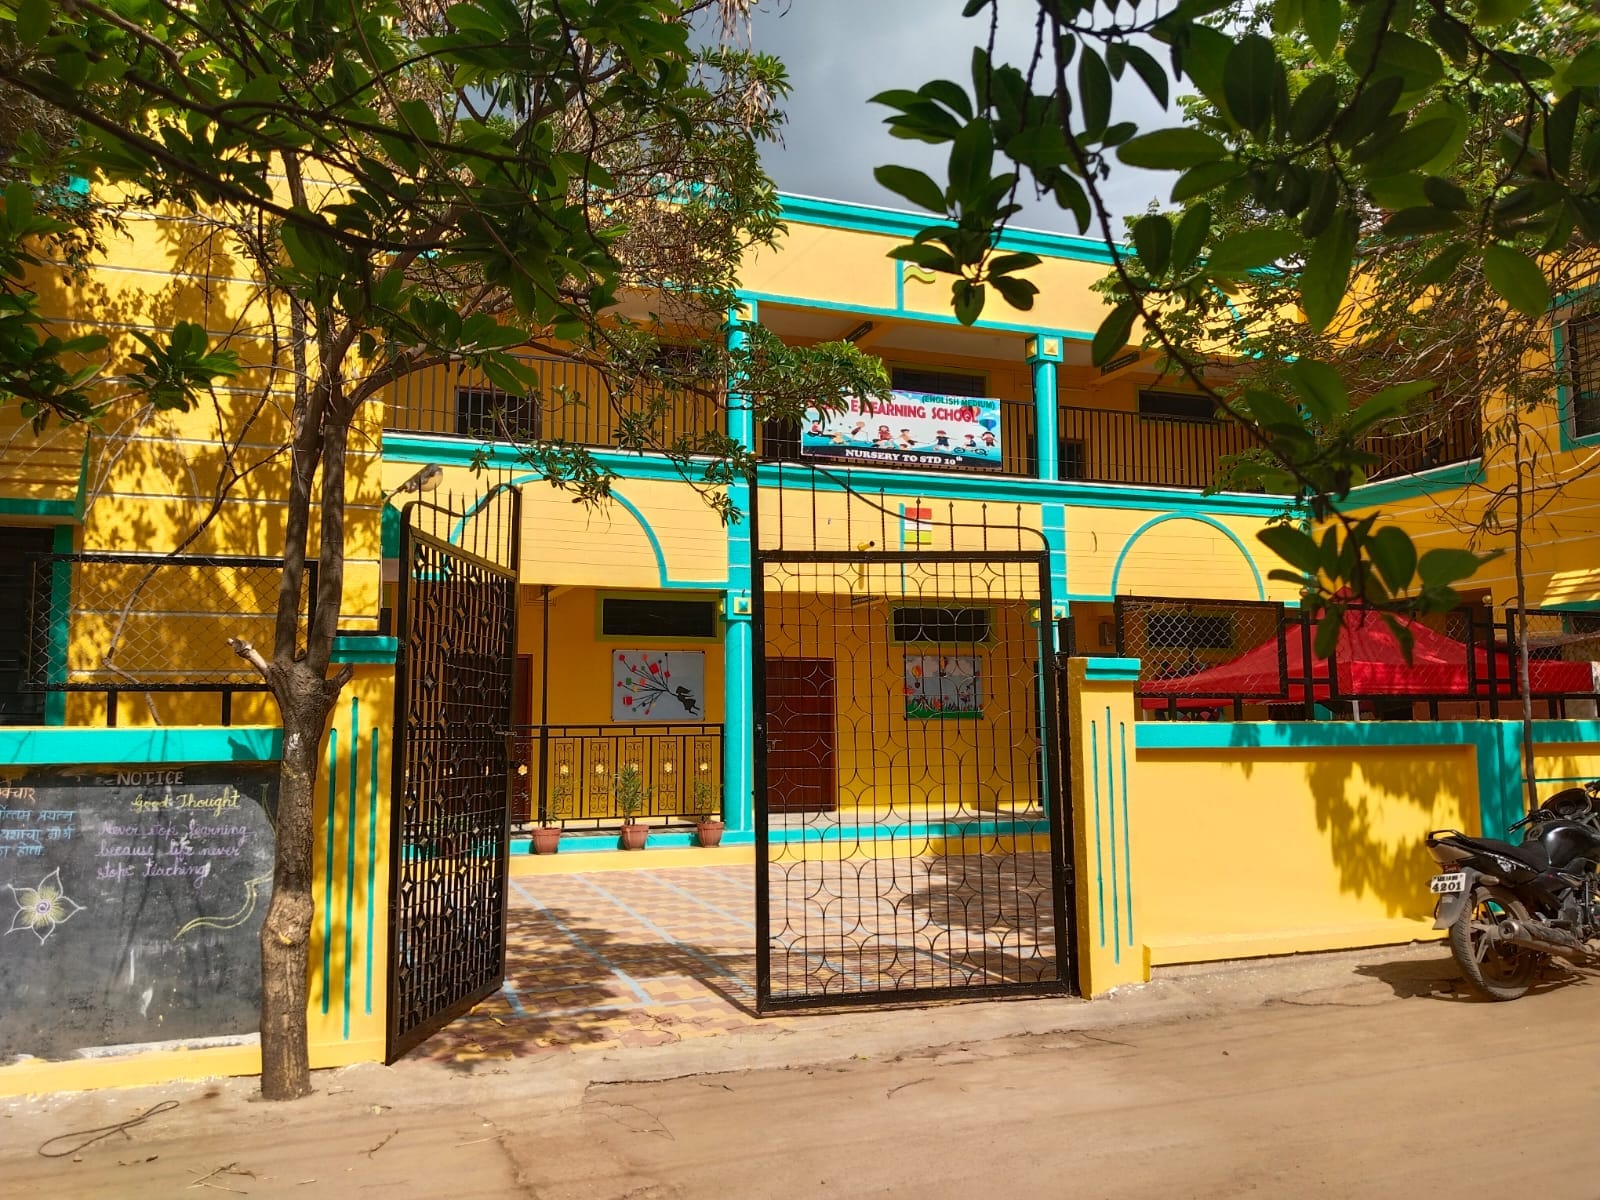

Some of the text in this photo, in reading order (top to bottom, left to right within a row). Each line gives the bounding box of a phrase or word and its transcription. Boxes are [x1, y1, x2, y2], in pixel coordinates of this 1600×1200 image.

[961, 399, 996, 411] MEDIUM)
[931, 406, 979, 424] SCHOOL
[845, 449, 963, 466] NURSERY TO STD 10th
[116, 771, 184, 786] NOTICE
[131, 786, 241, 817] Good Thought
[101, 818, 250, 847] Never stop learning
[95, 838, 242, 862] because life never
[142, 859, 212, 889] teaching
[1432, 882, 1461, 892] 4201
